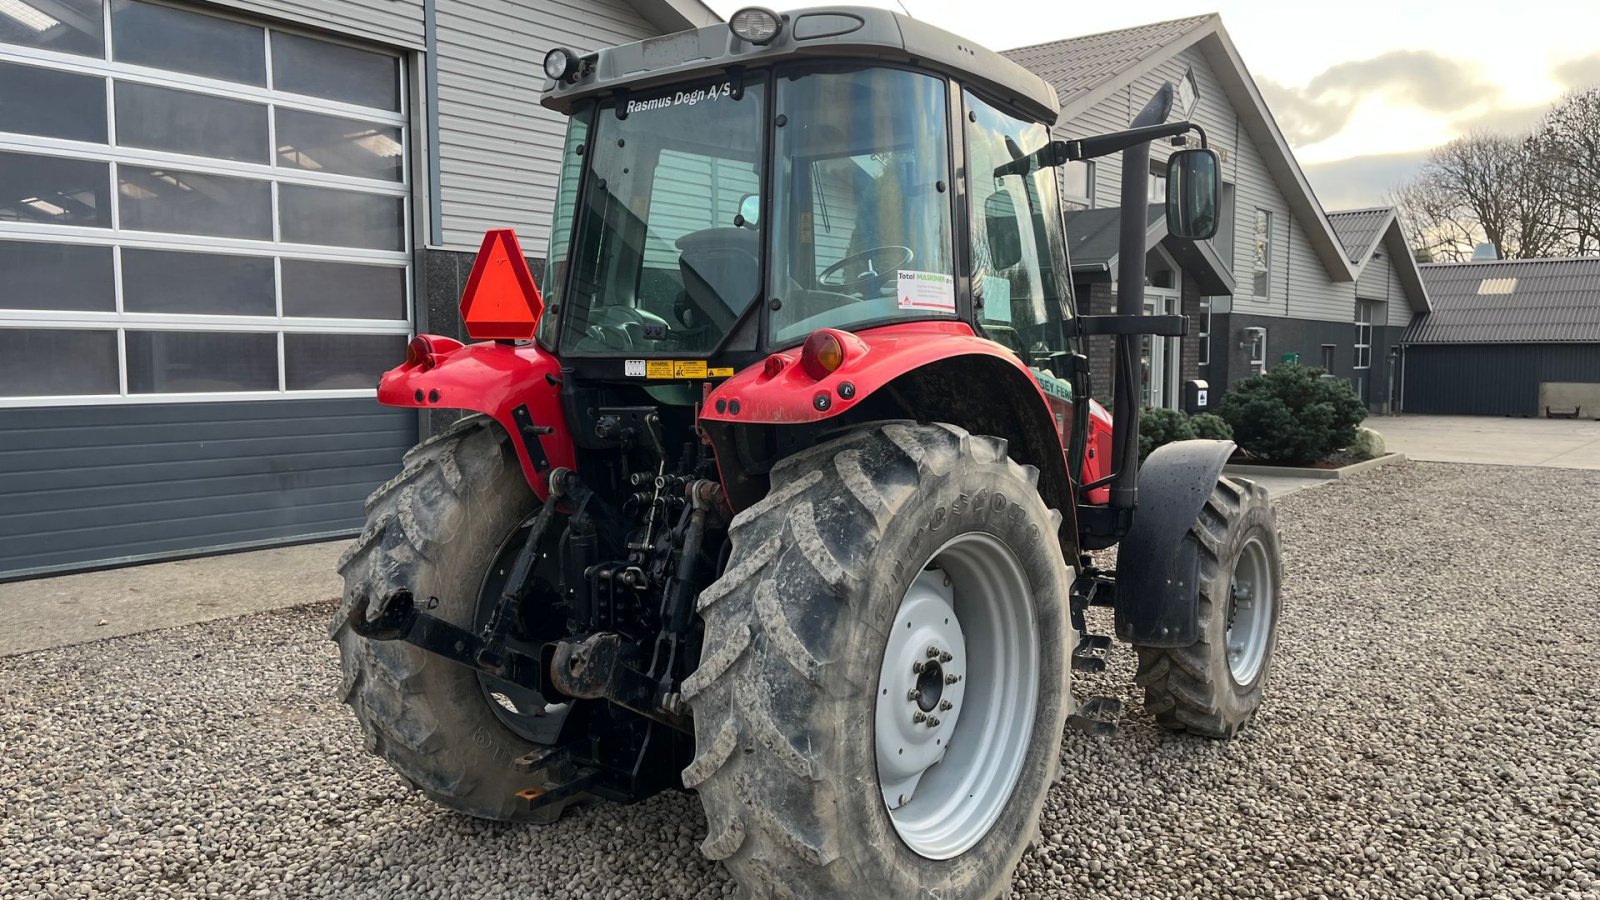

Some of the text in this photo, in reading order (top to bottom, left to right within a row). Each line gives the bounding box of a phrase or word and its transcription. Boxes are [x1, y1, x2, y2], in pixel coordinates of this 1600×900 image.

[626, 82, 731, 113] Rasmus Degn A/S
[899, 272, 915, 280] Total
